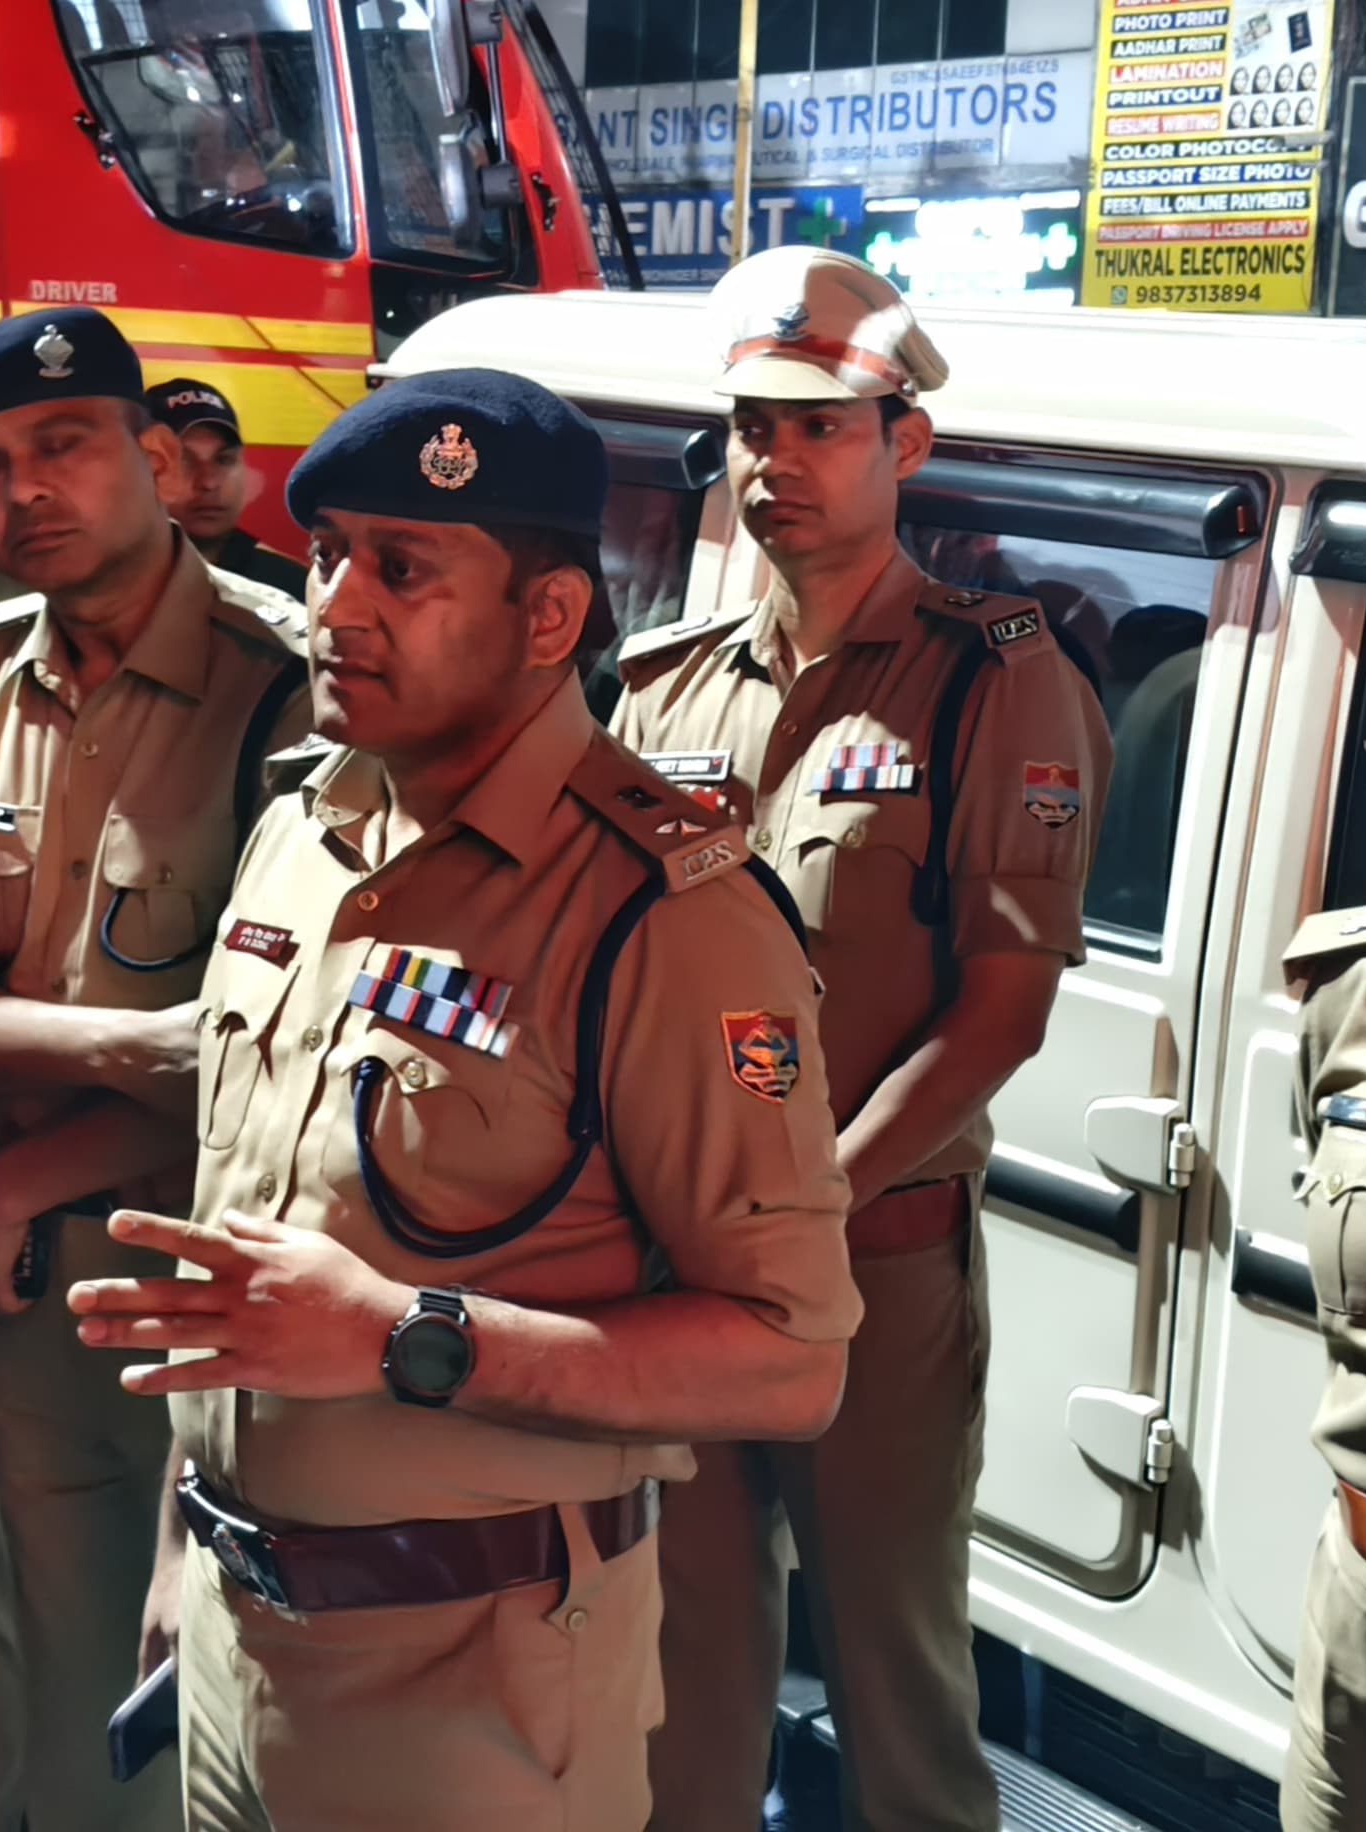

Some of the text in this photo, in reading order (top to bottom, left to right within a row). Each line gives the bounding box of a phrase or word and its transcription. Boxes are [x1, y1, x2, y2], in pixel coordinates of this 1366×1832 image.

[1114, 8, 1227, 32] PHOTO PRINT
[1112, 34, 1224, 57] AADHAR PRINT
[1109, 59, 1223, 85] LAMINATION
[1108, 86, 1220, 107] PRINTOUT
[762, 81, 1059, 141] DISTRIBUTORS
[1105, 141, 1173, 161] COLOR
[1101, 163, 1311, 187] PASSPORT SIZE PHOTO
[1101, 190, 1306, 215] FEES/BILL ONLINE PAYMENTS
[1267, 217, 1309, 235] APPLY
[1095, 245, 1306, 278] THUKRAL ELECTRONICS
[30, 280, 117, 304] DRIVER
[1136, 283, 1262, 304] 9837313894
